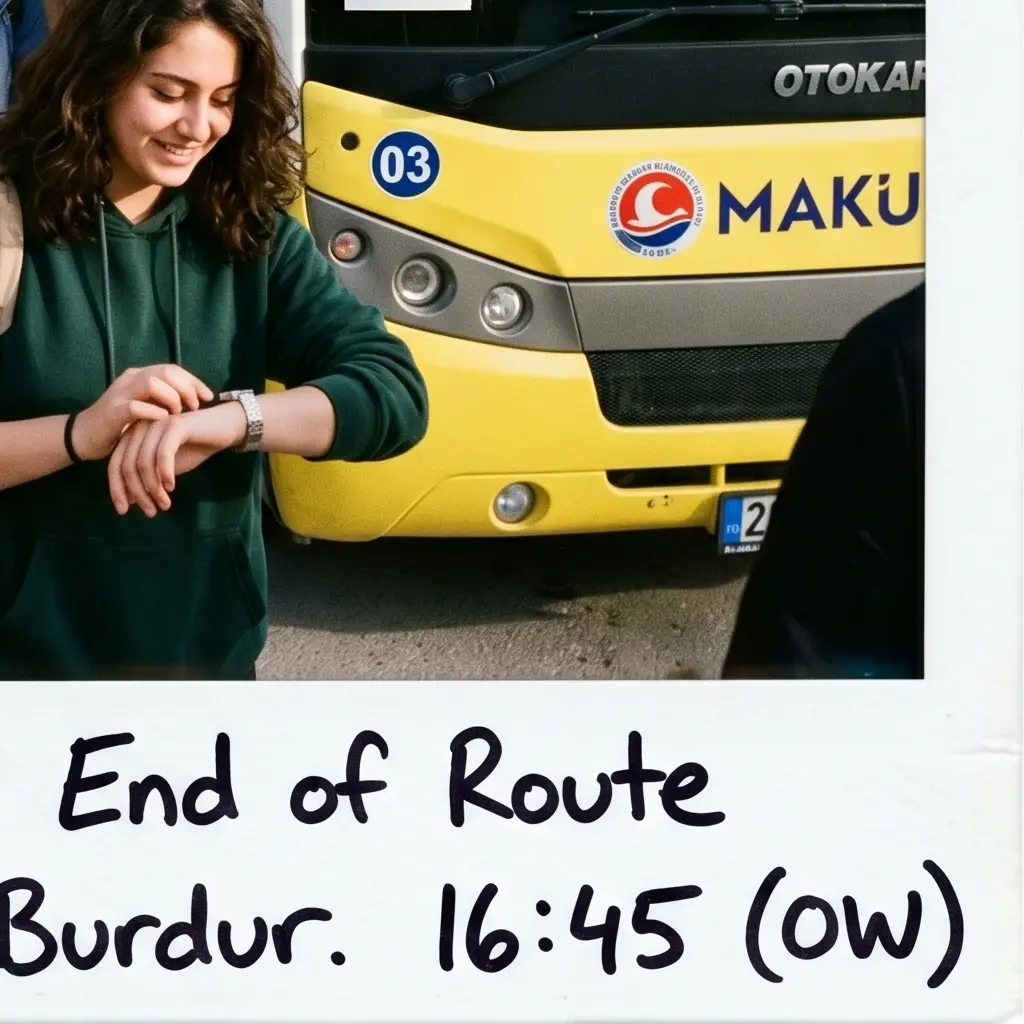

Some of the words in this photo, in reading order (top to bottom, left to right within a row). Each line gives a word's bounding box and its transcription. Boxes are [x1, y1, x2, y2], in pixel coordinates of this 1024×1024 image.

[380, 144, 431, 184] 03
[58, 731, 239, 832] End
[289, 729, 389, 825] of
[449, 726, 726, 828] Route
[438, 882, 703, 976] 16:45
[745, 859, 964, 989] (OW)
